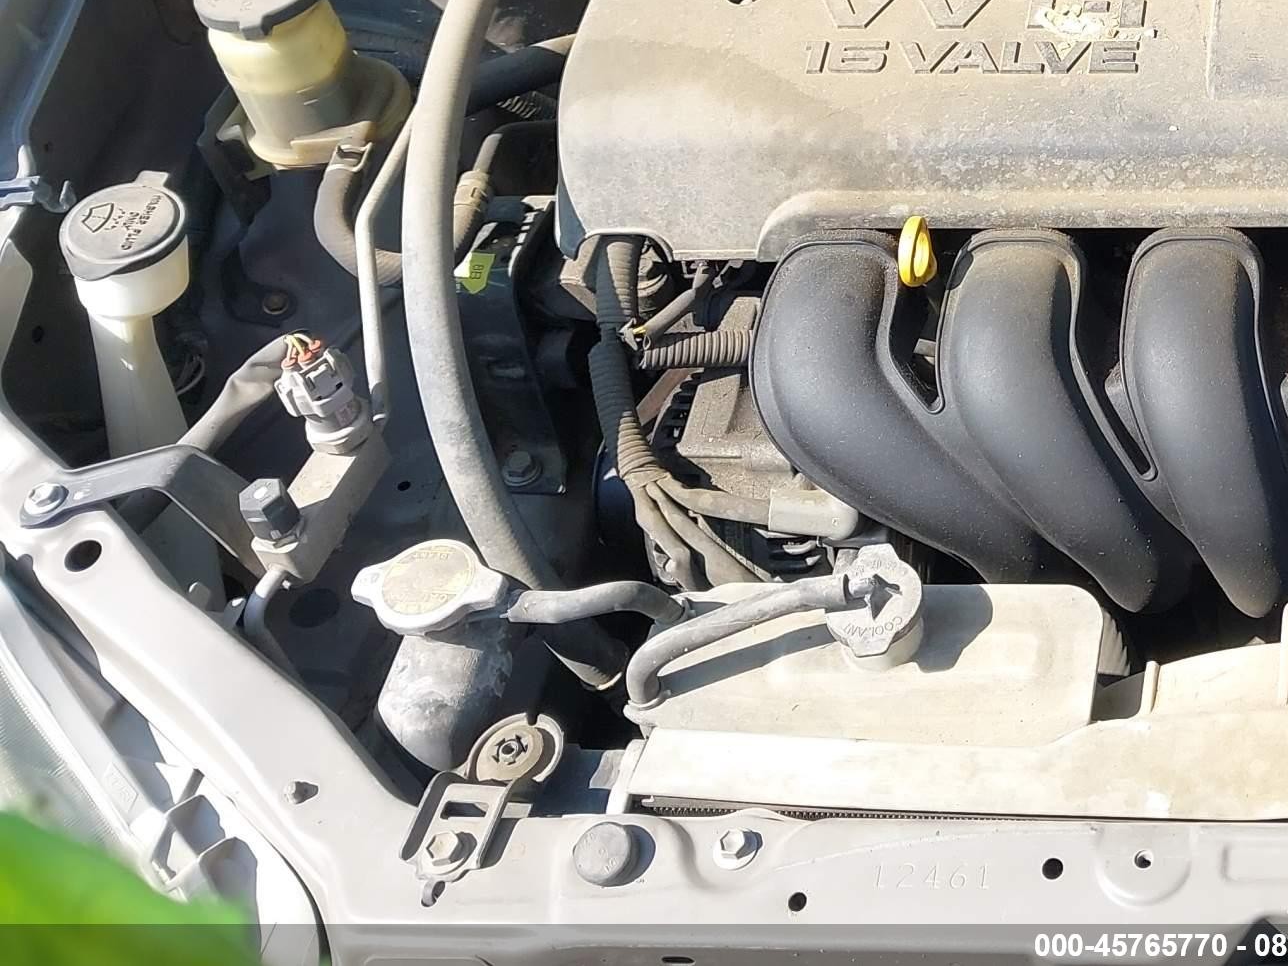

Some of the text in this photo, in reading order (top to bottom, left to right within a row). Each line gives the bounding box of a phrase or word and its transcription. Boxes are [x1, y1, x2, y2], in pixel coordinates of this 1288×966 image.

[806, 41, 1140, 74] 16 VALVE
[873, 863, 990, 890] 12461
